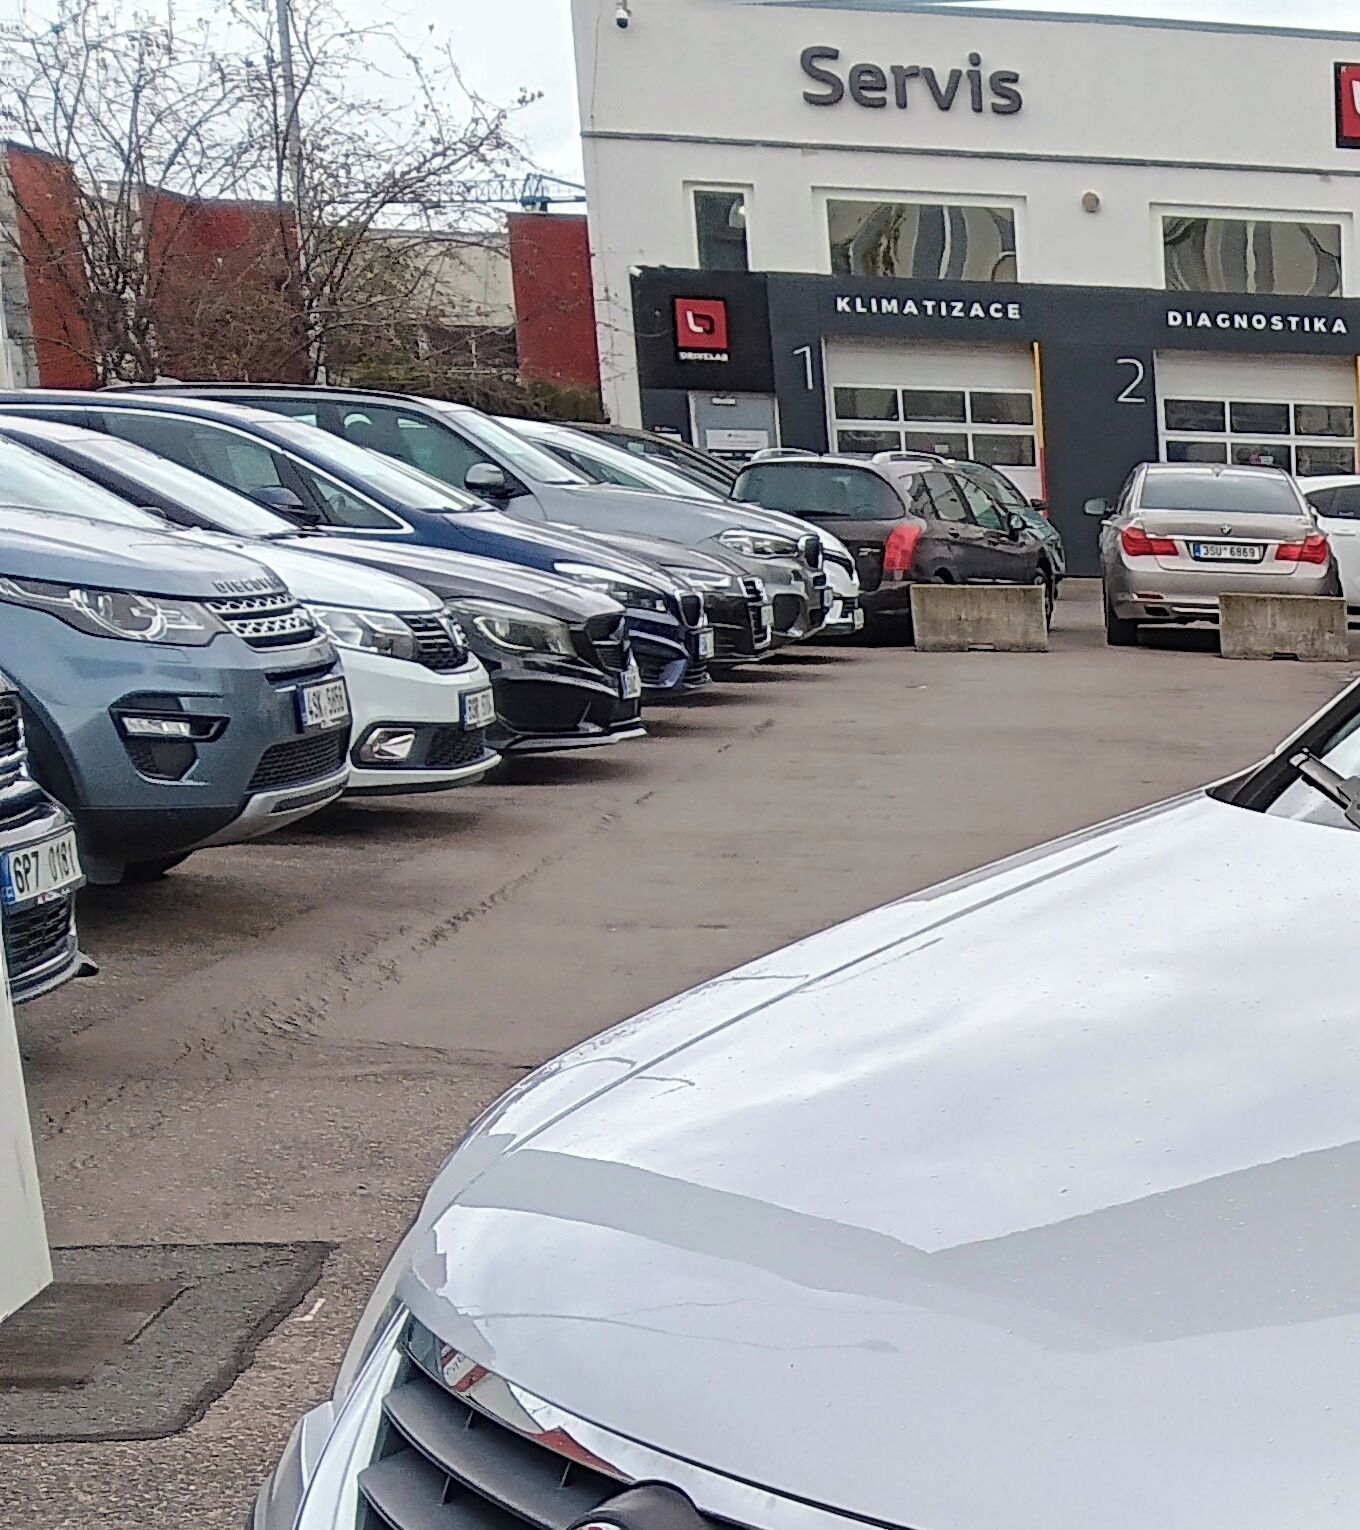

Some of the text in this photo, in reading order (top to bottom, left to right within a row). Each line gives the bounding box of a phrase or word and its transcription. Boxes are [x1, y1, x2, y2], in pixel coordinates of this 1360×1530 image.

[800, 45, 1023, 115] Servis
[835, 296, 1022, 320] KLIMATIZACE
[1166, 310, 1348, 335] DIAGNOSTIKA
[793, 345, 814, 390] 1
[1116, 358, 1146, 403] 2
[13, 850, 39, 894] 6P7
